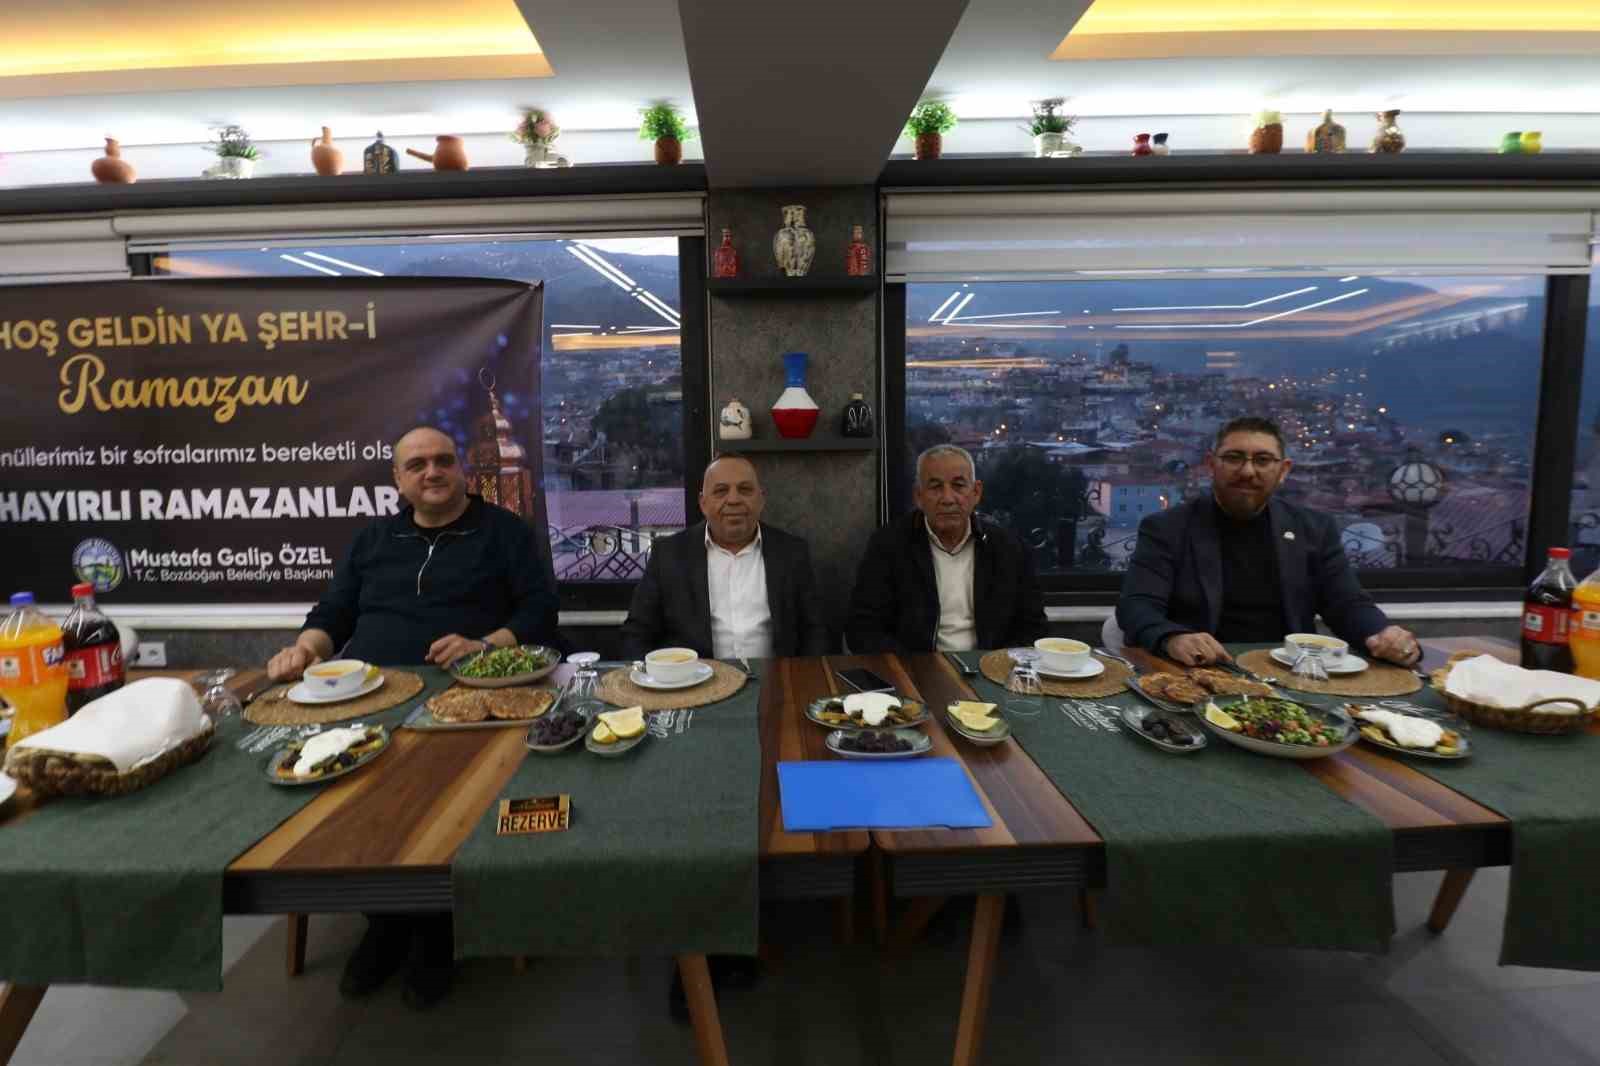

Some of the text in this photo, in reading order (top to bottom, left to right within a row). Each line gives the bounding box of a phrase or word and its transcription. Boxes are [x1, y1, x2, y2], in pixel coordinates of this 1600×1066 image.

[0, 301, 376, 357] HOŞ GELDİN YA ŞEHR-İ
[58, 352, 309, 424] Ramazan
[1, 440, 393, 468] nüllerimiz bir sofralarımız bereketli ols
[0, 485, 400, 522] HAYIRLI RAMAZANLAR
[130, 547, 212, 568] Mustafa
[217, 546, 274, 571] Galip
[278, 543, 333, 565] ÖZEL
[160, 567, 225, 584] Bozdoğan
[226, 567, 281, 583] Belediye
[500, 810, 566, 833] REZERVE
